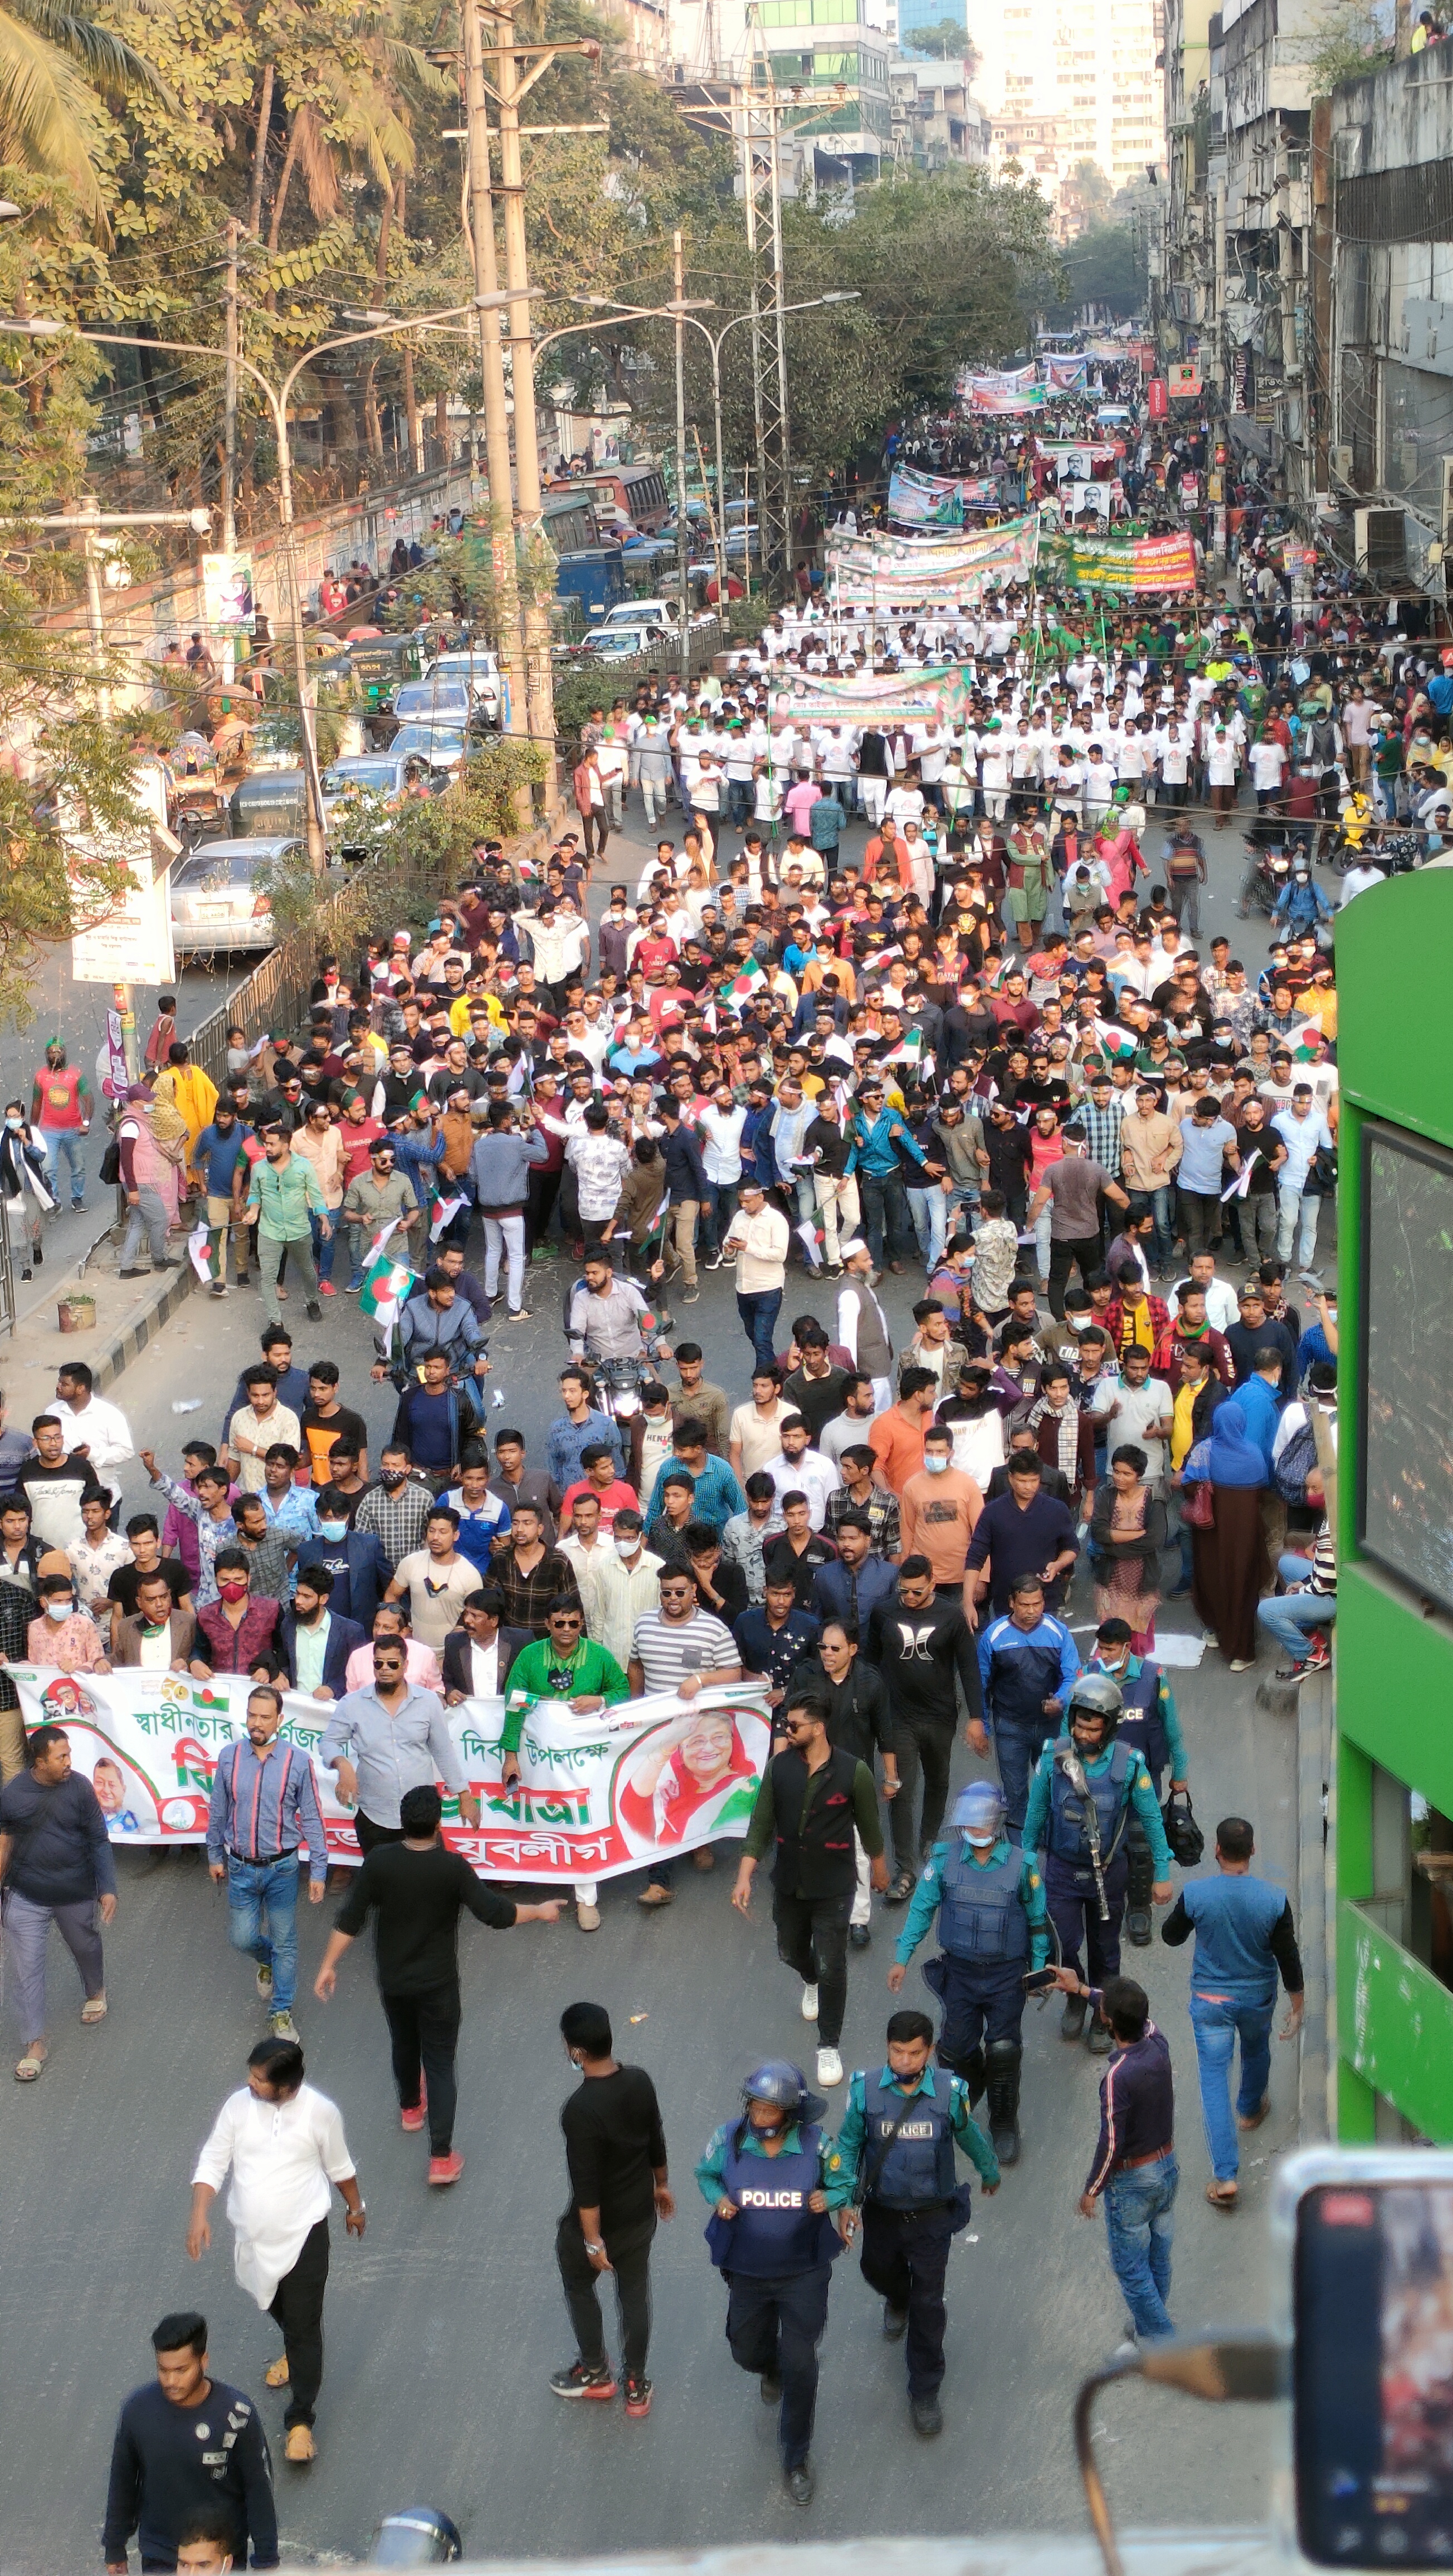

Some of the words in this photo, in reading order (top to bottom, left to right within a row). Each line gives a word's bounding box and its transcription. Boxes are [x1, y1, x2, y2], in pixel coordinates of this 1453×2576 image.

[131, 1702, 234, 1743] স্বাধীনতার
[525, 1734, 613, 1772] উপলক্ষে
[447, 1832, 613, 1868] যুবলীগ
[742, 2191, 802, 2207] POLICE
